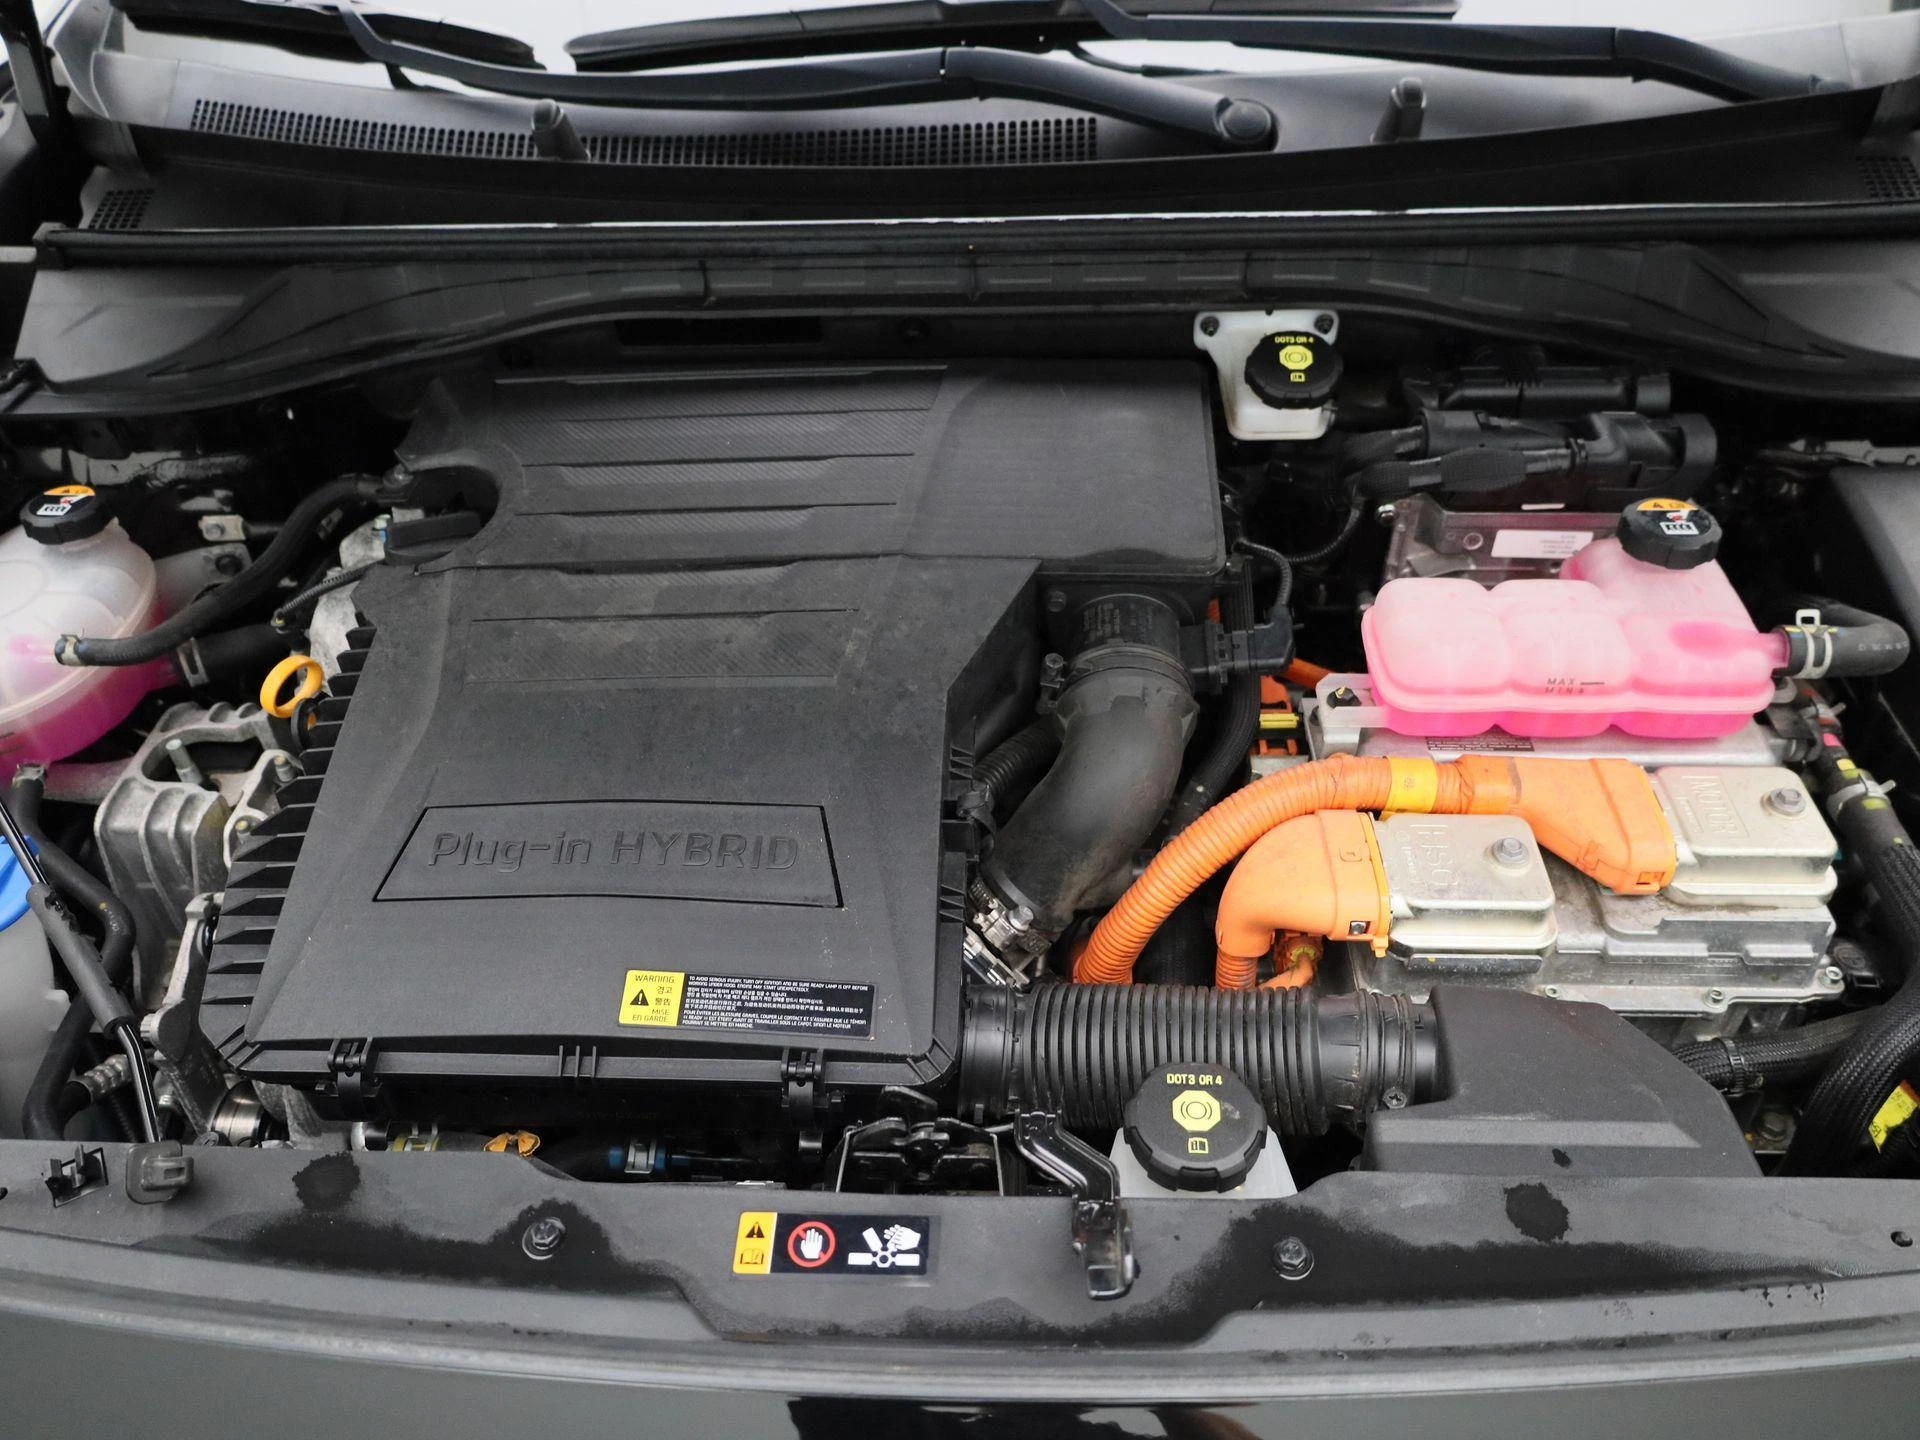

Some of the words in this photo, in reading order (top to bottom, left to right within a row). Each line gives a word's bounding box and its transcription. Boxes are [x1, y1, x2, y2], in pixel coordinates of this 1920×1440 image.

[427, 831, 592, 873] Plug-in
[609, 830, 798, 870] HYBRID
[636, 974, 674, 984] WARNING
[652, 1008, 670, 1016] MISE
[1199, 1074, 1213, 1084] OR
[1215, 1075, 1222, 1085] 4
